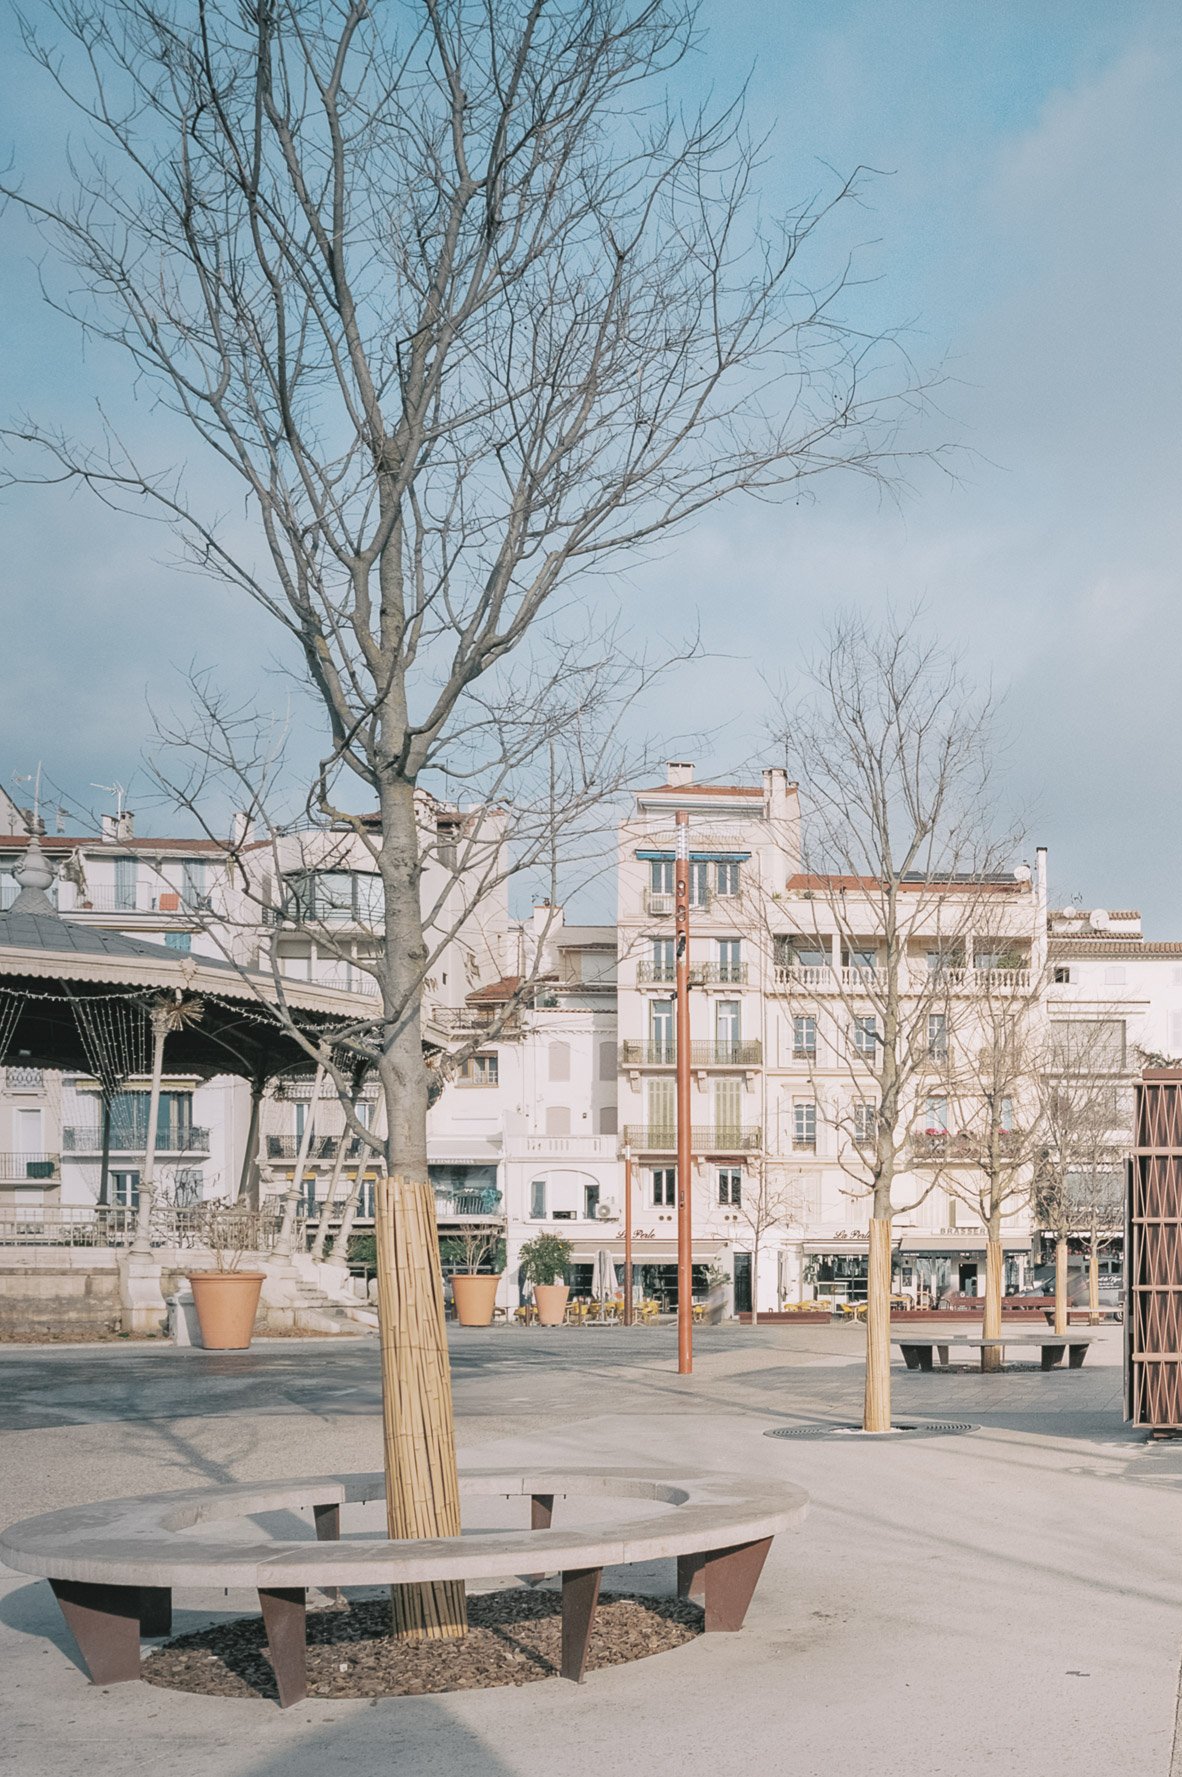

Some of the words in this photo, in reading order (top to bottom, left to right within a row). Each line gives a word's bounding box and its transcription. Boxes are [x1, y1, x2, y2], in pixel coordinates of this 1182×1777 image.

[633, 1229, 656, 1238] Perle
[833, 1230, 847, 1239] La
[850, 1230, 870, 1239] Perl
